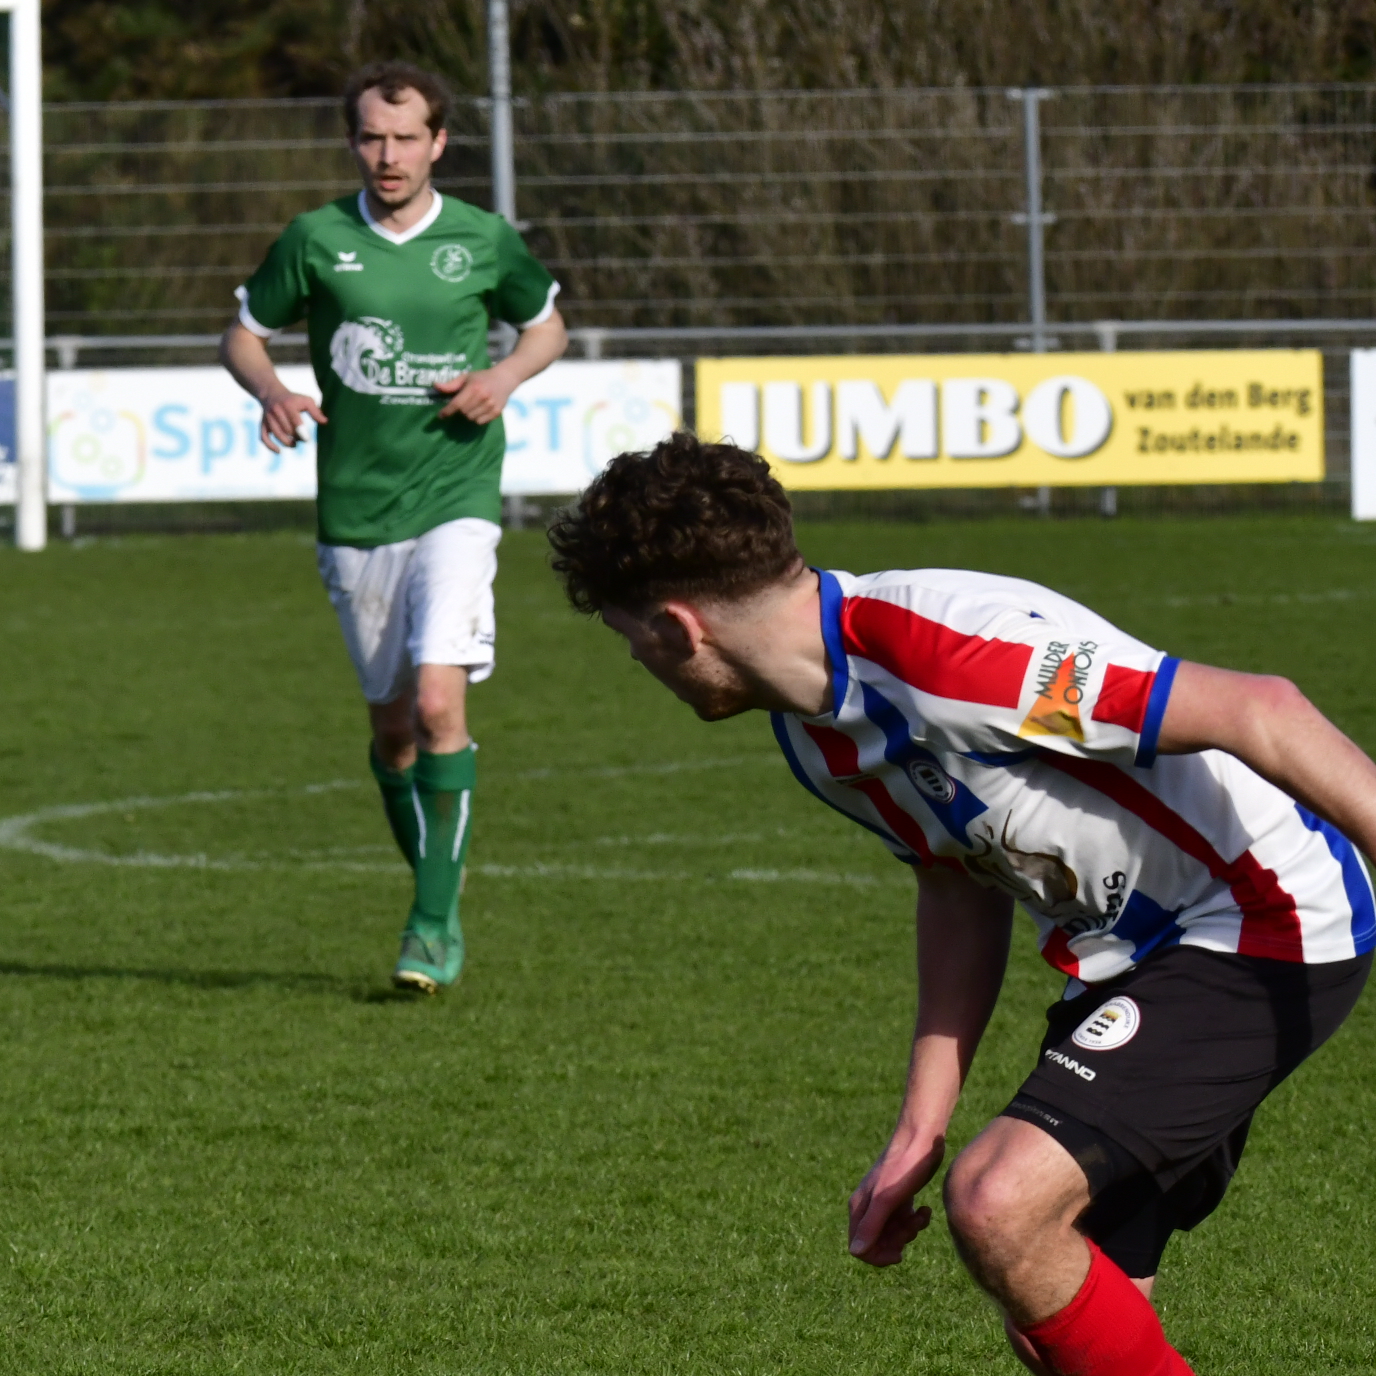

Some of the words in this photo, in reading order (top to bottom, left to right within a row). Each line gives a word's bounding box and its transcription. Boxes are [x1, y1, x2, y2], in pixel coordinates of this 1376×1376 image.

[721, 375, 1112, 463] JUMBO
[1124, 389, 1176, 409] van
[1184, 381, 1238, 409] den
[1247, 381, 1312, 417] Berg
[1137, 422, 1299, 454] Zoutelande
[1033, 640, 1071, 701] MULDER
[1062, 640, 1099, 705] ONIONS
